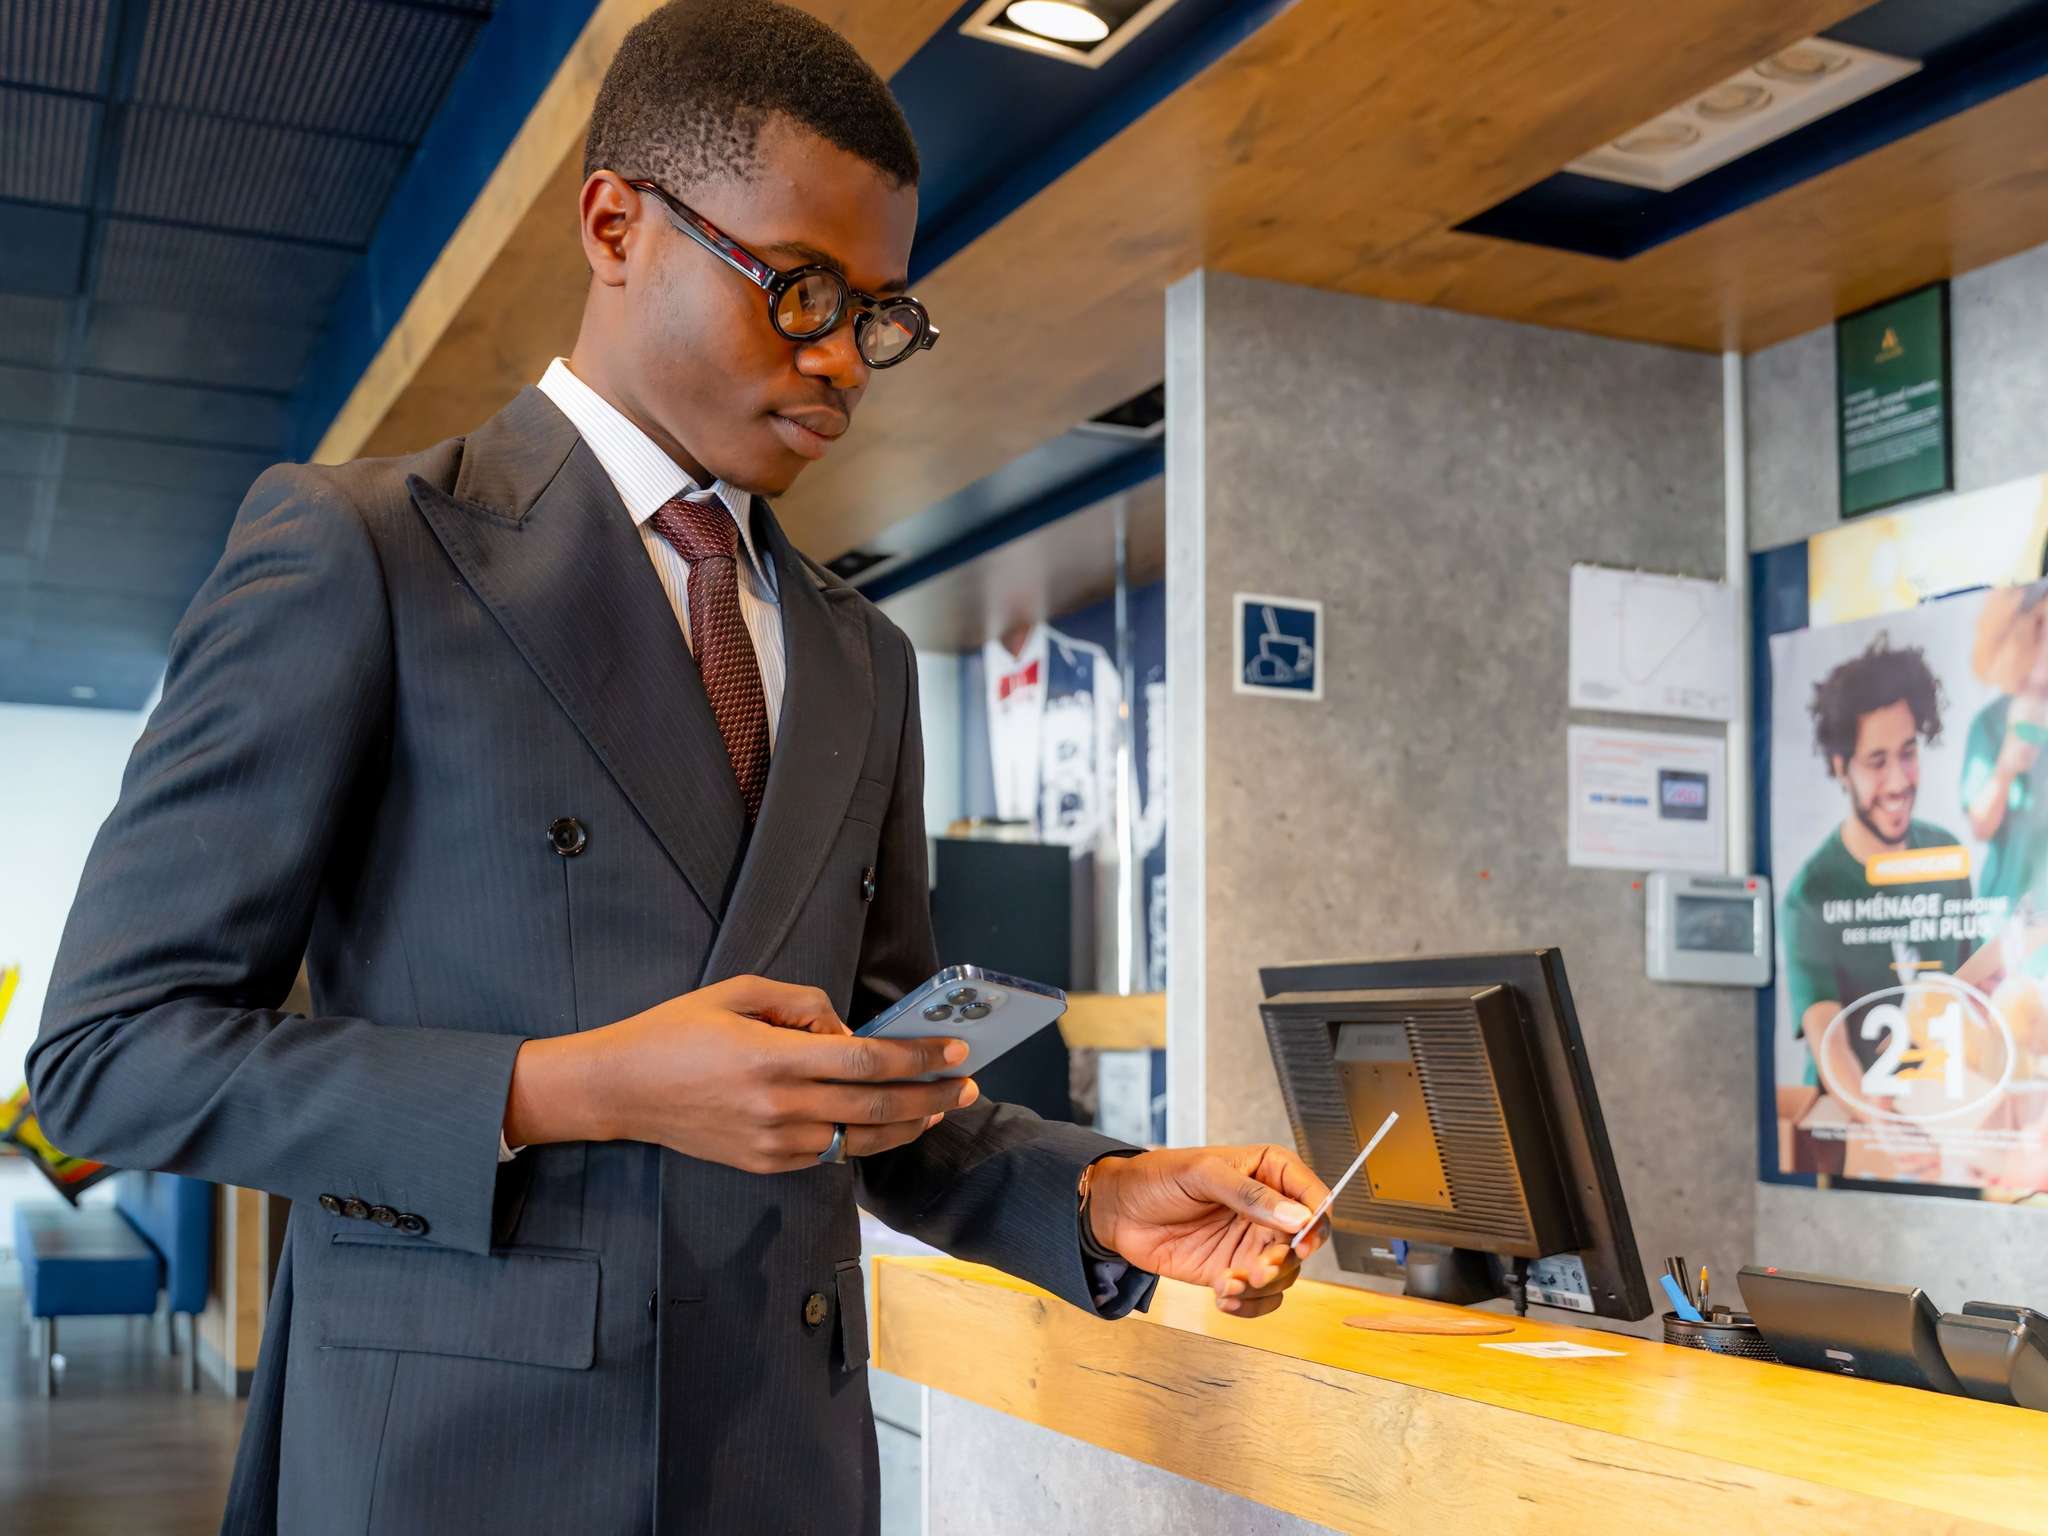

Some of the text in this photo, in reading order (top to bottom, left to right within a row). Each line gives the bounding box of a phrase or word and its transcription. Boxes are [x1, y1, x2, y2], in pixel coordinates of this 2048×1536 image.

[1823, 899, 1851, 923] UN
[1855, 892, 1941, 920] MÉNAGE
[1909, 919, 1937, 942] EN
